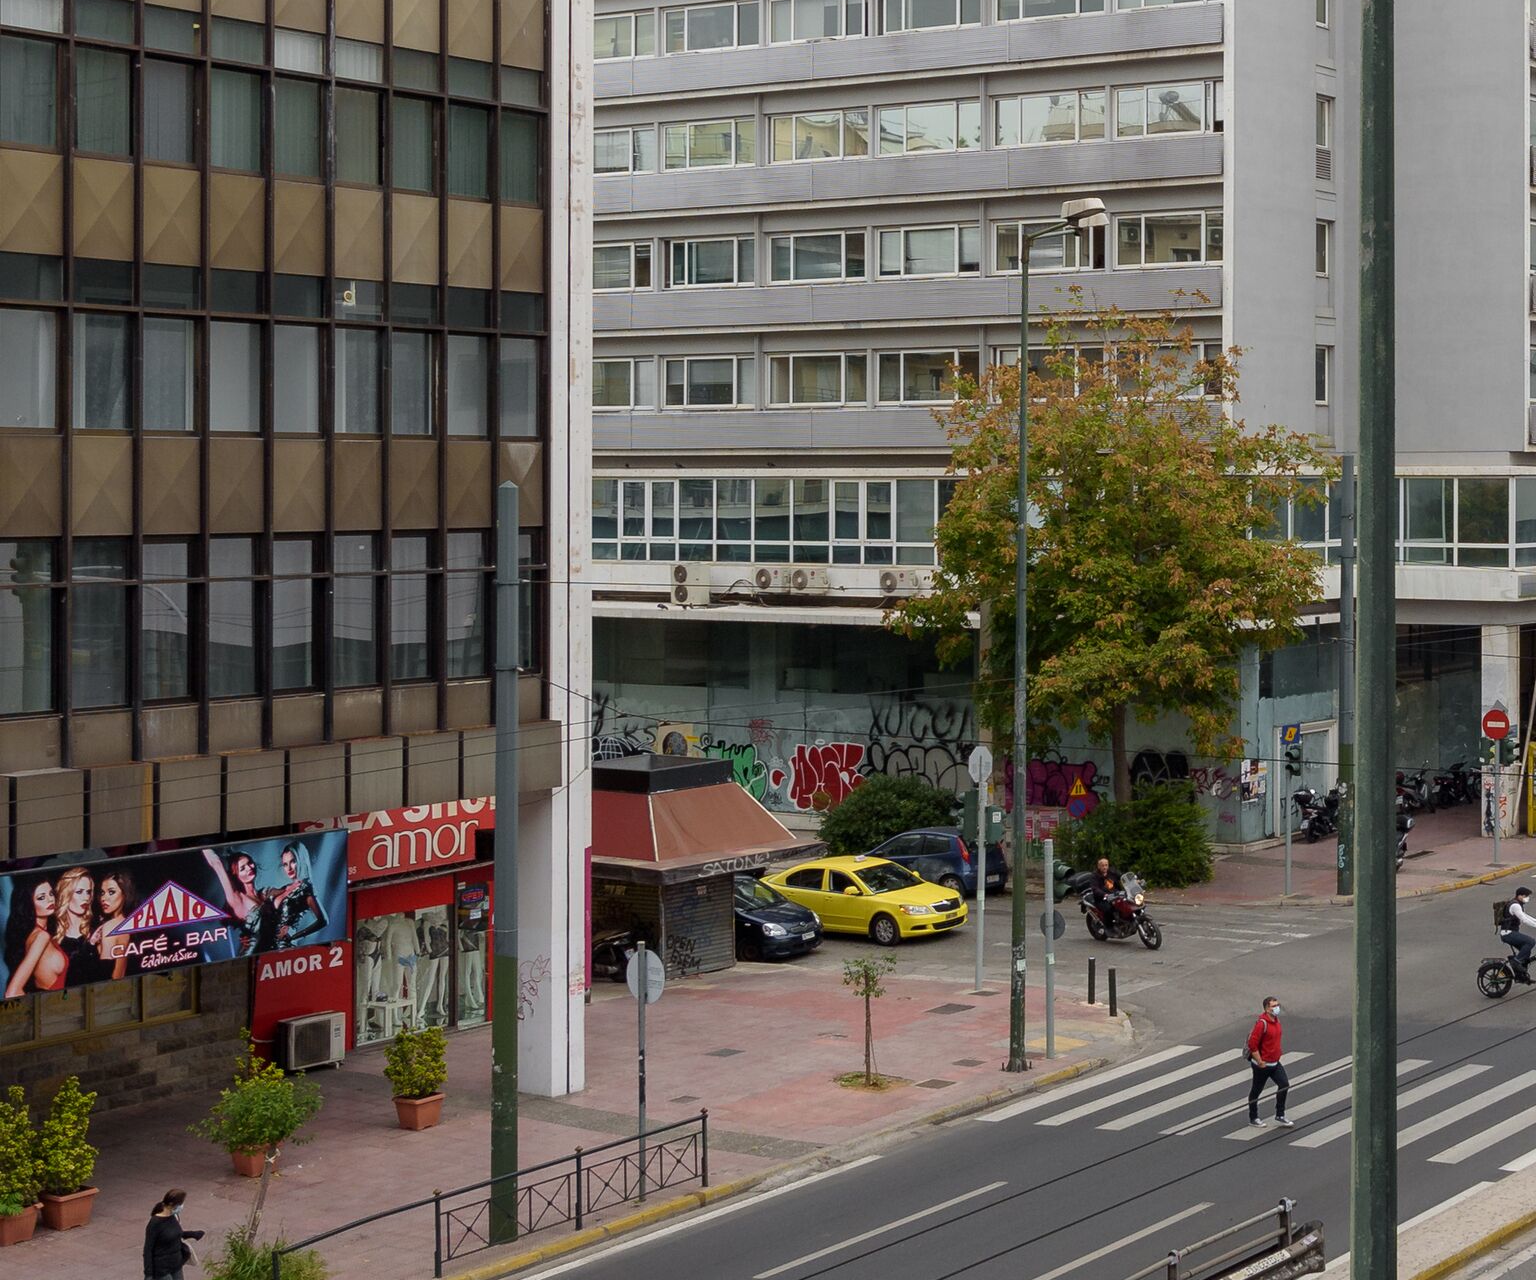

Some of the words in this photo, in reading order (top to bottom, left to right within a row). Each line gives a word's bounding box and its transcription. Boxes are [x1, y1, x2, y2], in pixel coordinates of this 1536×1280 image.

[367, 820, 479, 870] amor
[133, 886, 206, 929] ΡΑΔΙΟ
[111, 934, 168, 959] CAFÉ
[186, 927, 228, 947] BAR
[260, 954, 323, 982] AMOR
[328, 946, 344, 968] 2
